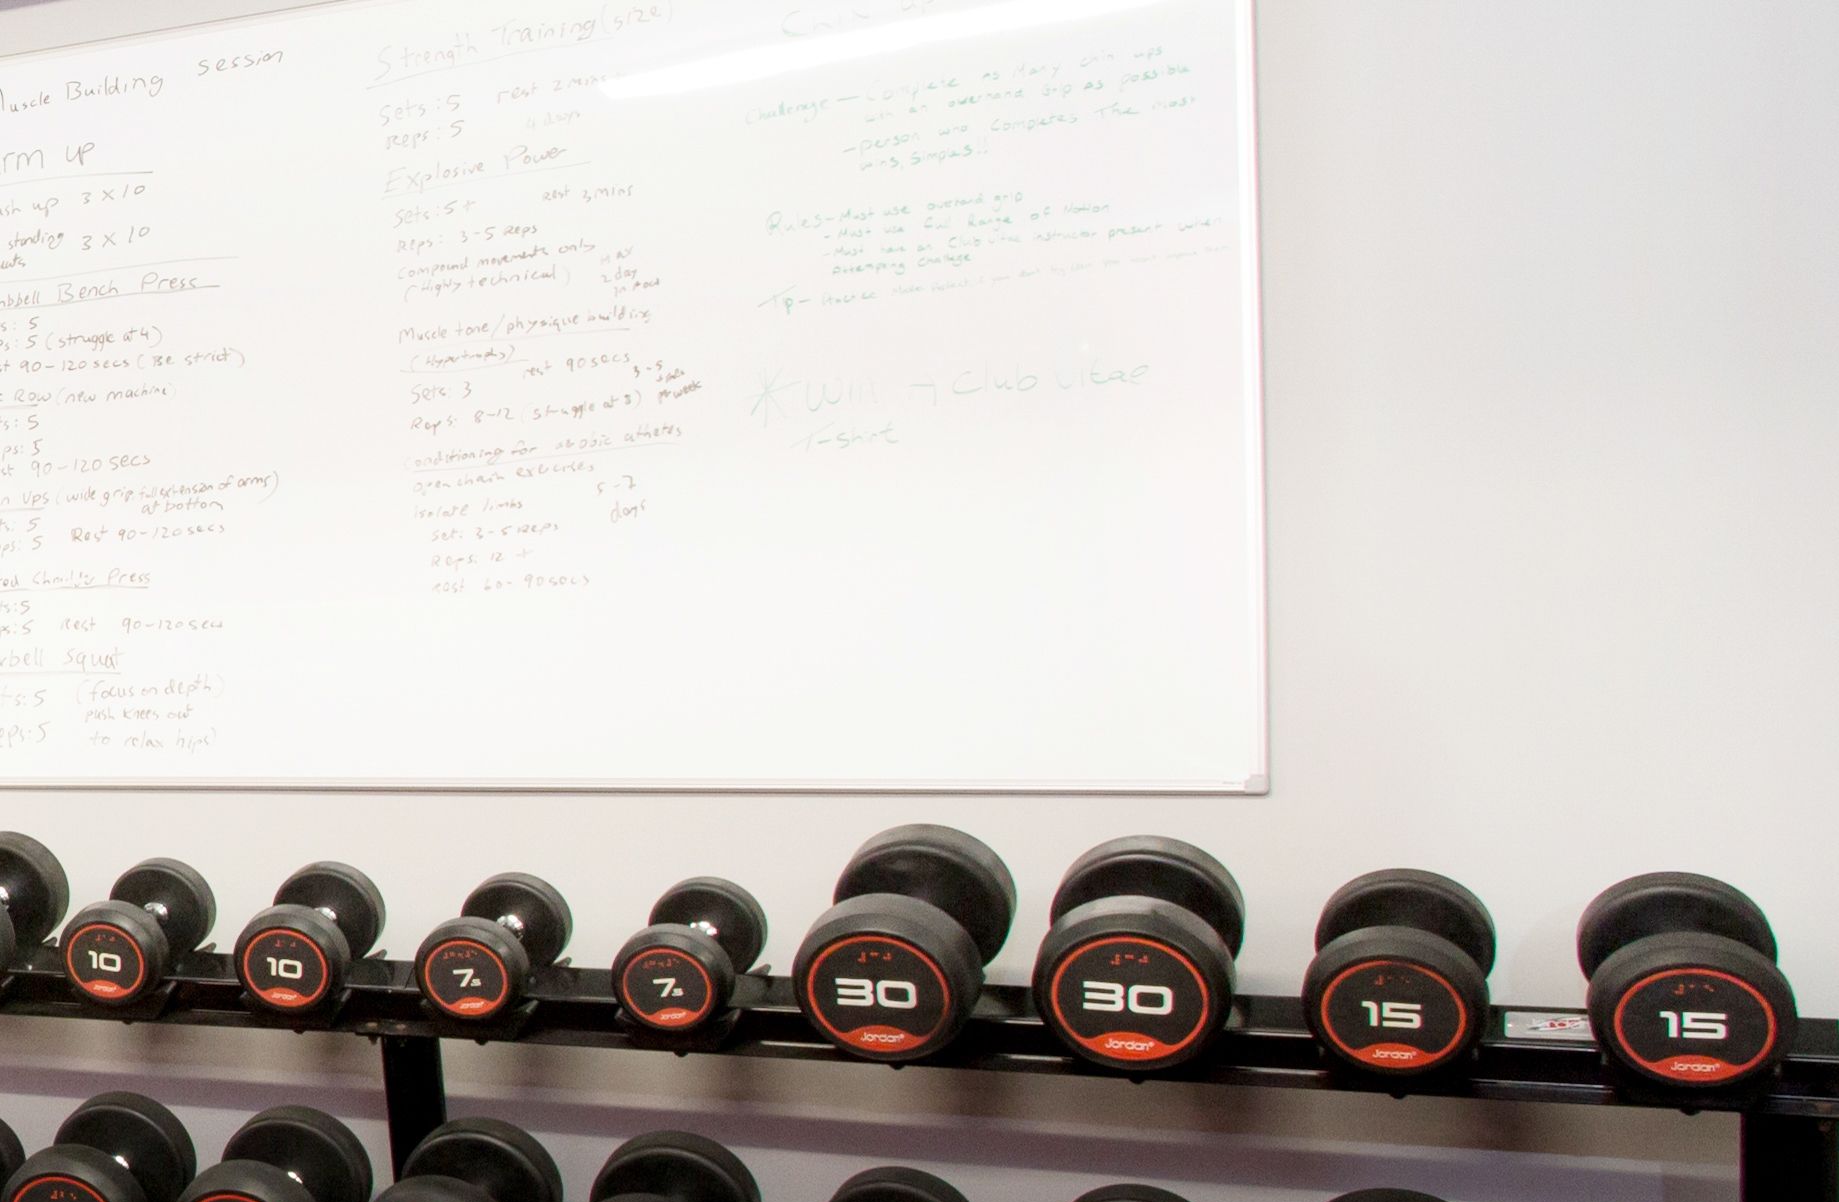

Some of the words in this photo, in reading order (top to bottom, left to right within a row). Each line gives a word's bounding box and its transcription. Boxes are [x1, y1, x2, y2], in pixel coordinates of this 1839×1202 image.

[65, 74, 165, 101] Building
[33, 197, 60, 219] up
[80, 190, 93, 205] 3
[80, 234, 93, 252] 3
[127, 225, 152, 244] 10
[57, 281, 120, 305] Bench
[140, 270, 199, 293] Press
[27, 315, 41, 332] 5
[25, 334, 38, 350] 5
[26, 412, 41, 432] 5
[26, 516, 42, 533] 5
[31, 535, 45, 551] 5
[32, 688, 48, 708] 5
[36, 720, 51, 744] 5
[86, 949, 123, 972] 10
[266, 956, 303, 979] 10
[835, 977, 918, 1010] 30
[1082, 979, 1174, 1016] 30
[1360, 1000, 1423, 1030] 15
[1659, 1010, 1729, 1041] 15
